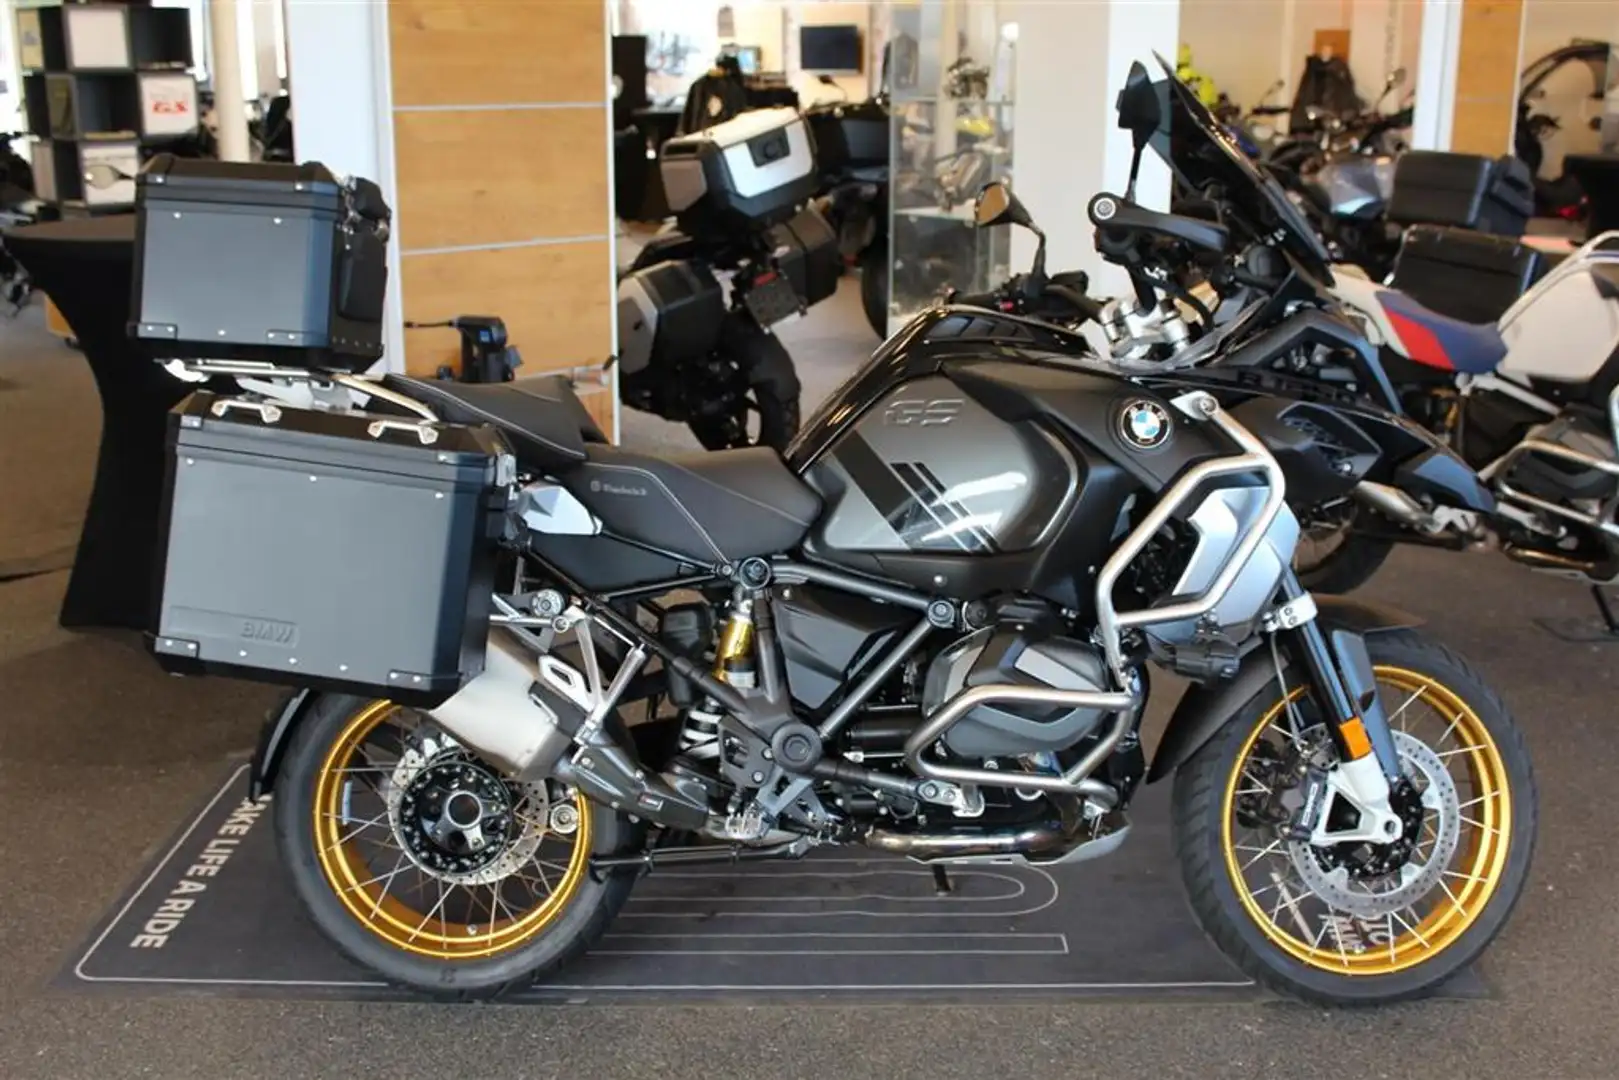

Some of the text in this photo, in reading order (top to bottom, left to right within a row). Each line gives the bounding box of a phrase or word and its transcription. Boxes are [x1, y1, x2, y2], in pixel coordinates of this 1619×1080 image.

[241, 621, 295, 644] BMW
[129, 793, 273, 949] AKE LIFE A RIDE
